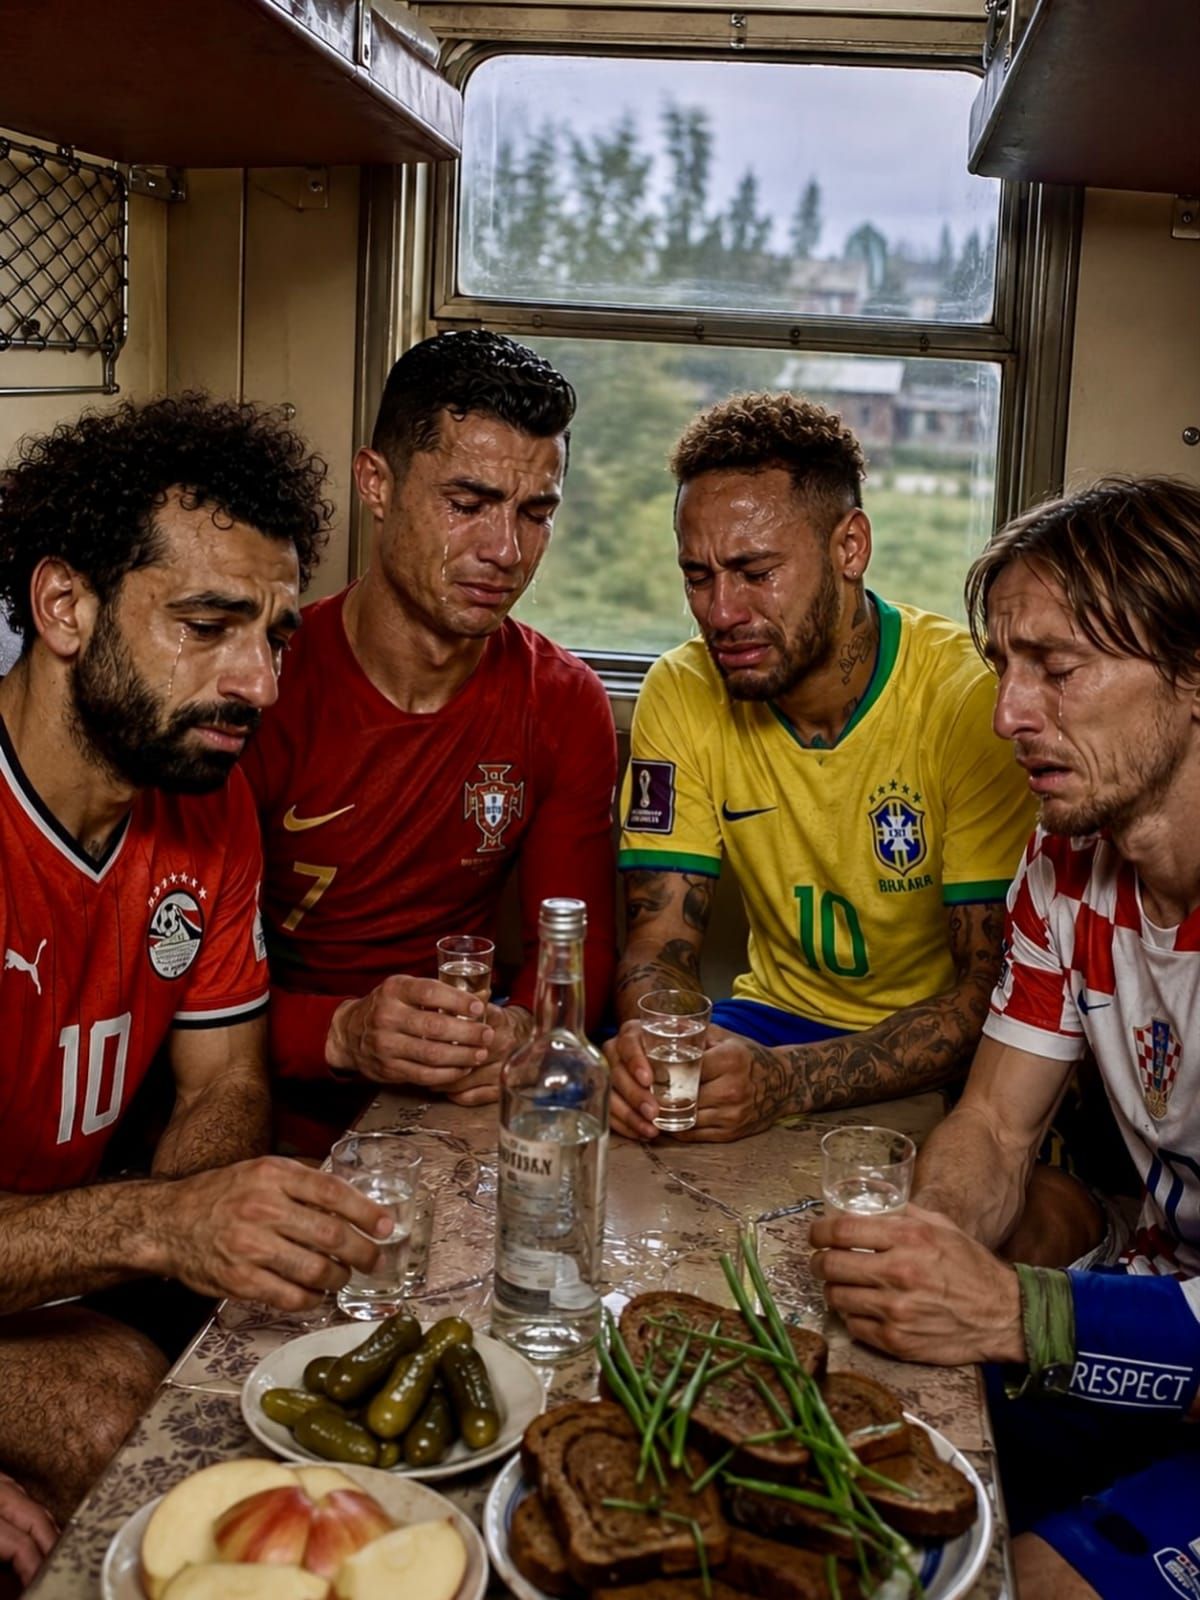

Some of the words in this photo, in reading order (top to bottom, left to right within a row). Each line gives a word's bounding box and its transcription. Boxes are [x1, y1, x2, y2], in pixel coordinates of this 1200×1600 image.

[282, 861, 338, 931] 7
[794, 886, 869, 977] 10
[57, 1011, 131, 1145] 10
[1069, 1361, 1190, 1401] RESPECT
